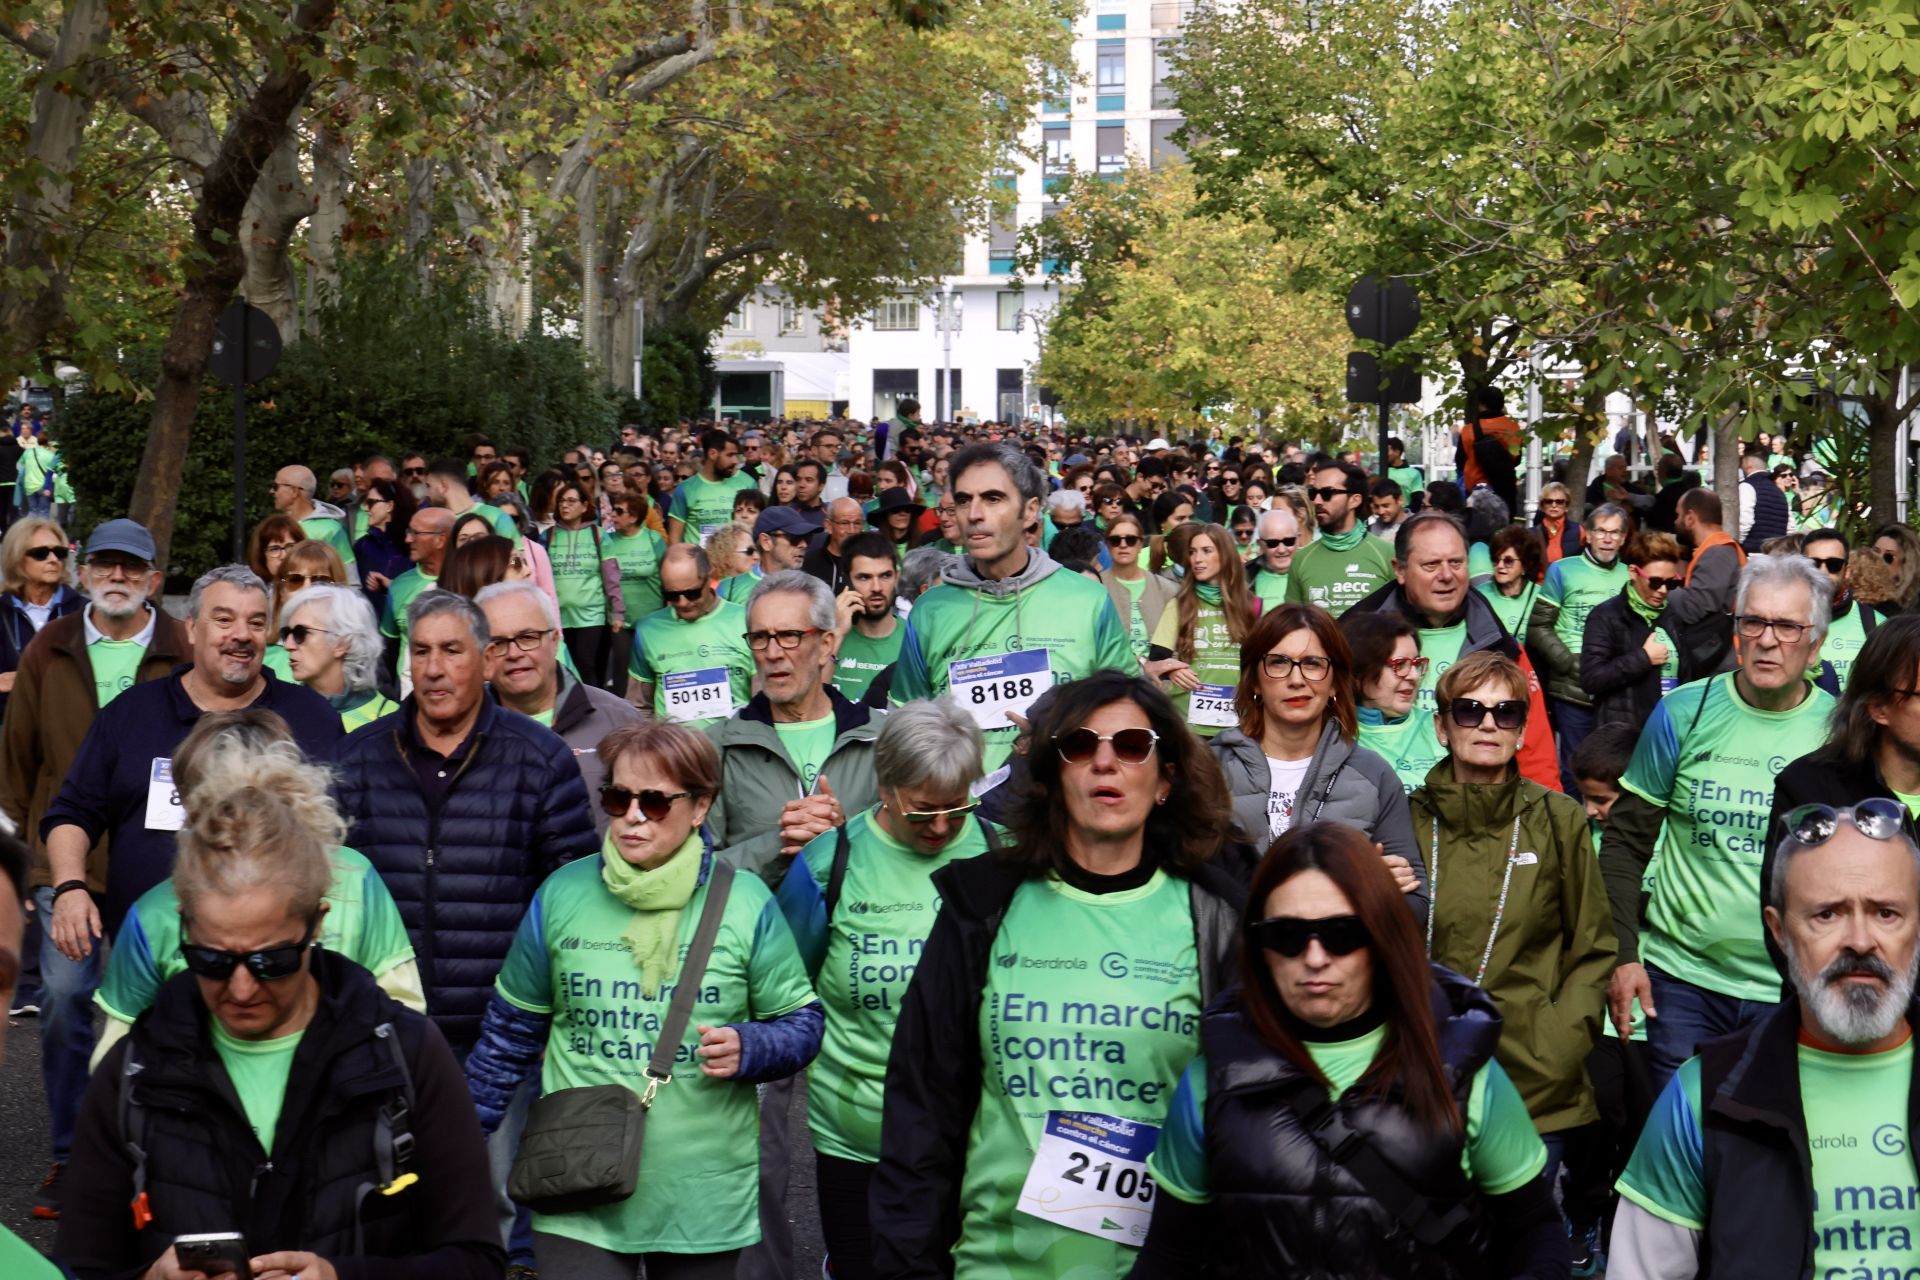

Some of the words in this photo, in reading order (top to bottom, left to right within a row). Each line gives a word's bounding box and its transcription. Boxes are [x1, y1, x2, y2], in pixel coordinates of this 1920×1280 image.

[1333, 581, 1370, 593] aecc
[671, 686, 721, 705] 50181
[971, 678, 1034, 704] 8188
[1714, 754, 1760, 767] Iberdrola
[1700, 780, 1731, 801] En
[1697, 808, 1767, 831] contr
[1698, 829, 1720, 849] el
[870, 901, 924, 914] Iberdrola
[863, 933, 898, 955] En
[1020, 955, 1088, 970] Iberdrola
[570, 972, 602, 998] En
[862, 987, 892, 1010] el
[574, 1005, 660, 1032] contra
[1002, 993, 1048, 1022] En
[1061, 1001, 1195, 1036] marcha
[576, 1032, 595, 1057] el
[600, 1035, 700, 1063] cáner
[1004, 1032, 1126, 1064] contra
[1007, 1066, 1041, 1098] el
[1048, 1067, 1168, 1104] cáncer
[1081, 1114, 1136, 1137] Valladolid
[1056, 1126, 1088, 1140] contra
[1088, 1135, 1099, 1144] el
[1098, 1138, 1132, 1155] cáncer
[1061, 1151, 1154, 1203] 2105
